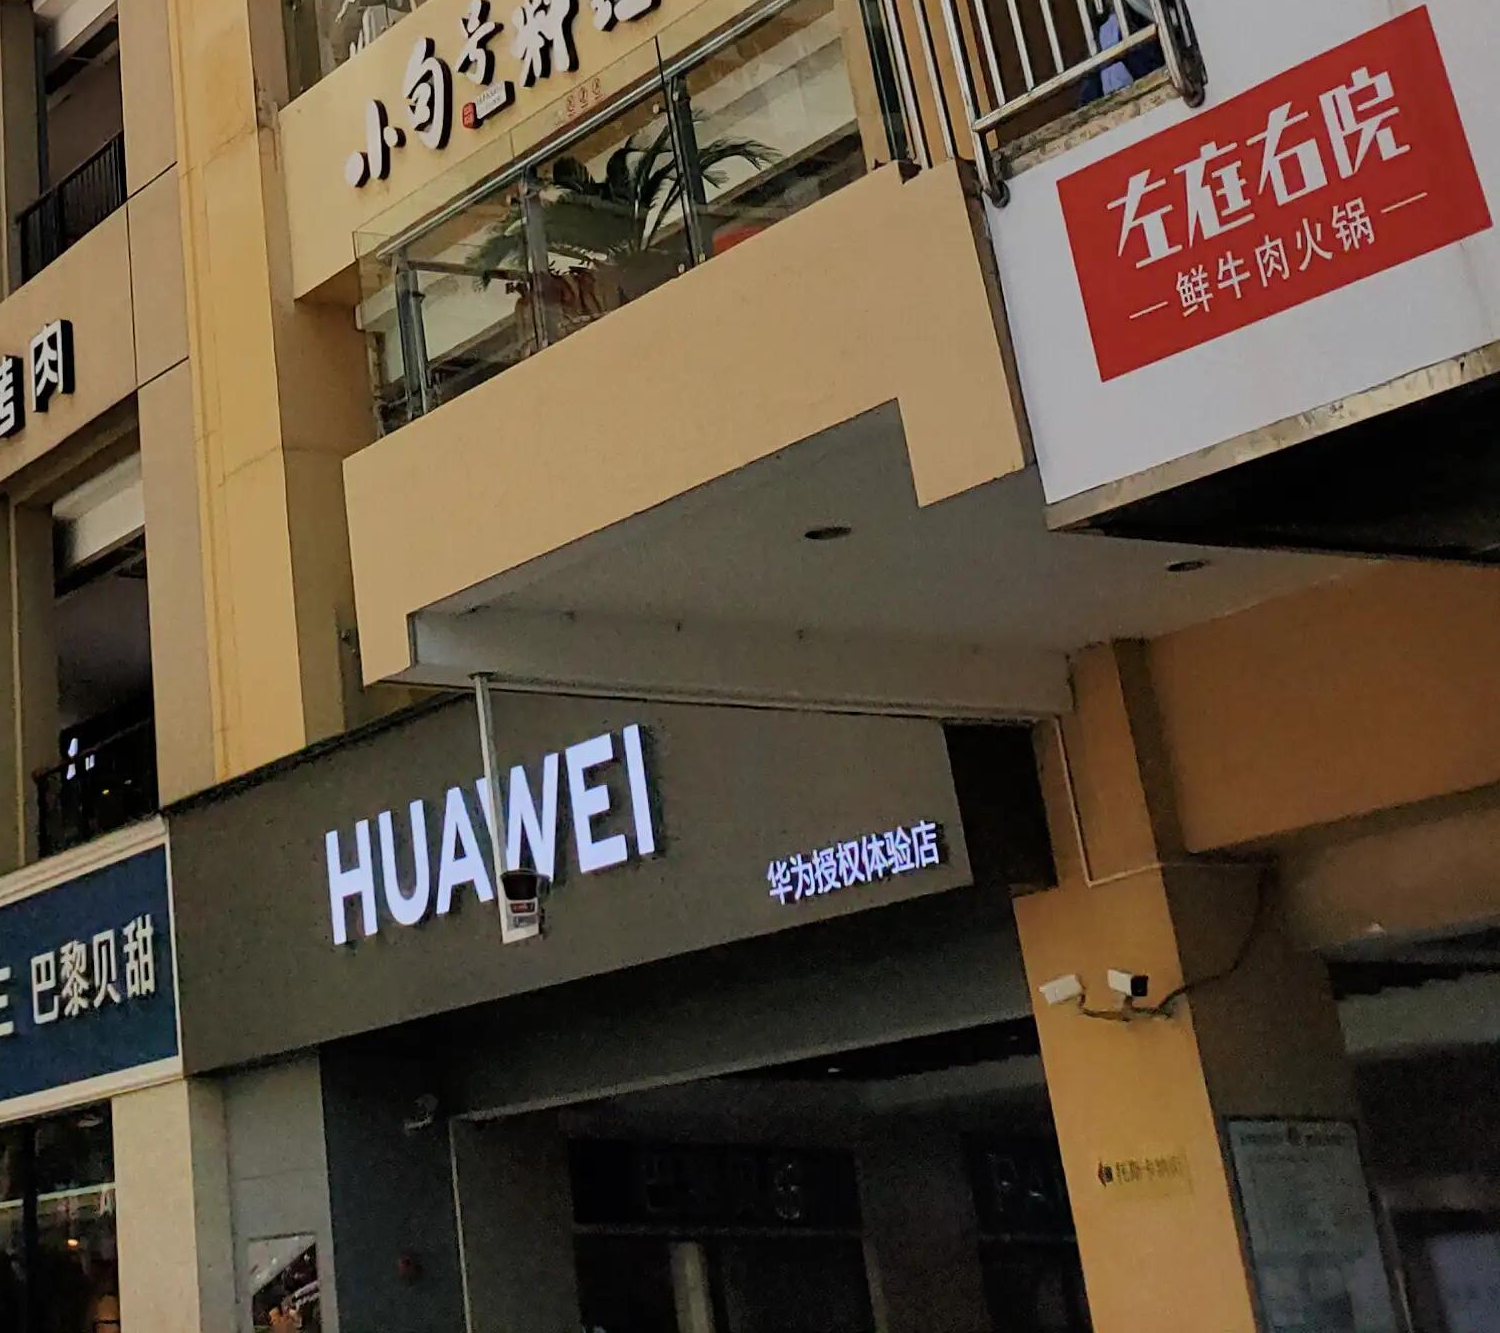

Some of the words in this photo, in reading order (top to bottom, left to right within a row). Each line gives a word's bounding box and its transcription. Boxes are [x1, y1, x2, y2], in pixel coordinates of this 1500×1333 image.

[1107, 66, 1411, 270] 左庭右院
[1176, 196, 1375, 318] 鲜牛肉火锅
[325, 723, 655, 946] HUAWEI
[766, 820, 939, 904] 华为授权体验店
[30, 914, 156, 1026] 巴黎贝甜
